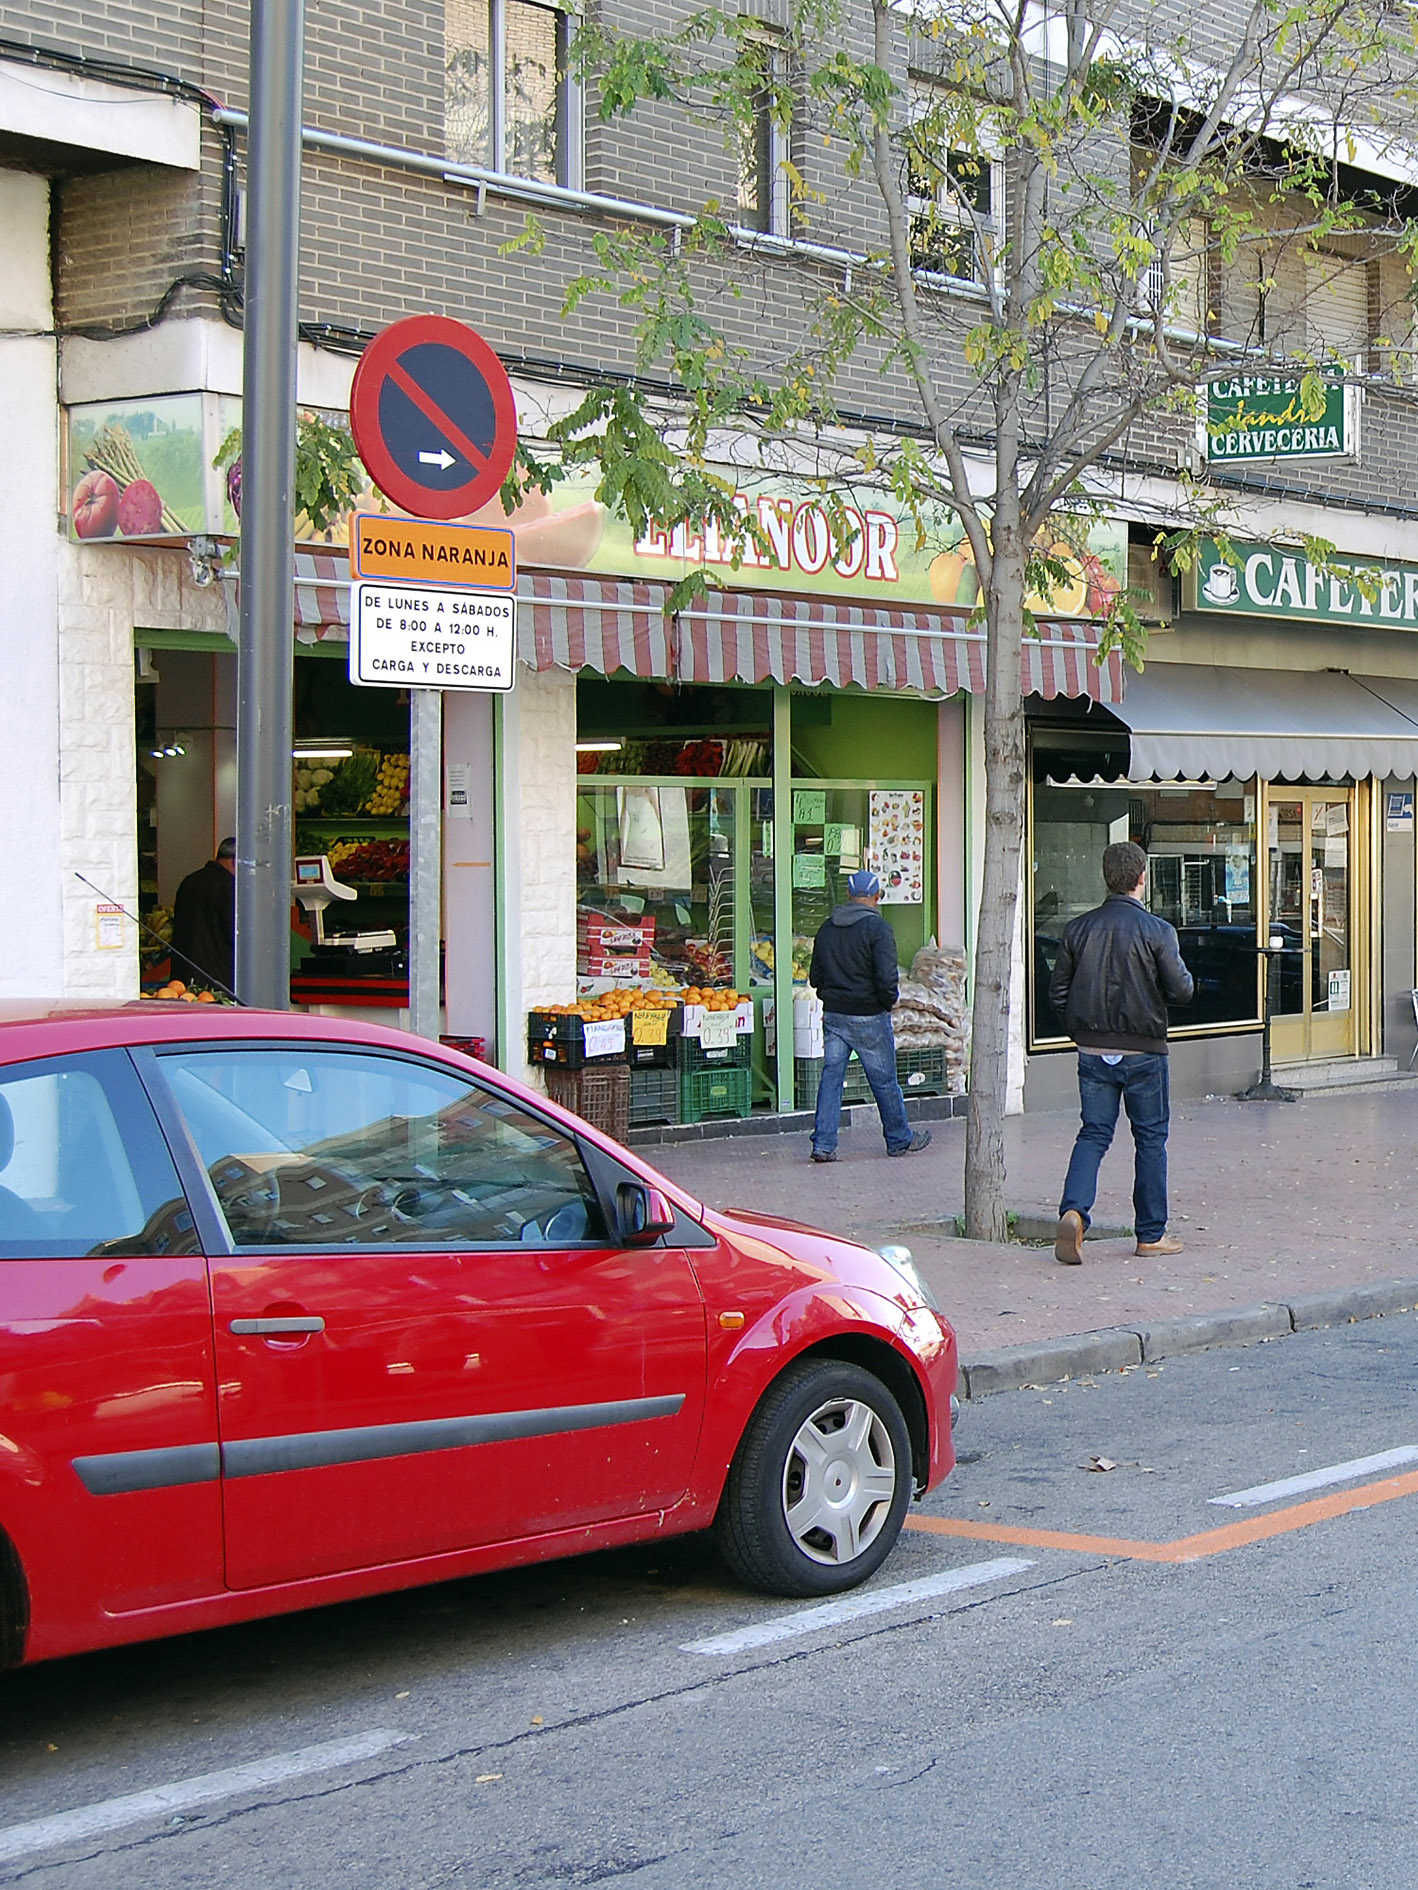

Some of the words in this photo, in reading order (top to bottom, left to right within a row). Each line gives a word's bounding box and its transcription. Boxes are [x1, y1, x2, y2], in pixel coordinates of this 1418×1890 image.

[363, 538, 416, 559] ZONA
[422, 543, 509, 568] NARANJA
[365, 596, 381, 608] DE
[388, 598, 429, 612] LUNES
[437, 602, 445, 613] A
[452, 602, 510, 618] SÁBADOS
[376, 618, 392, 630] DE
[400, 619, 427, 632] 8:00
[434, 622, 442, 633] A
[449, 623, 480, 636] 12:00
[411, 641, 465, 655] EXCEPTO
[372, 659, 414, 672] CARGA
[422, 662, 430, 673] Y
[436, 663, 502, 677] DESCARGA
